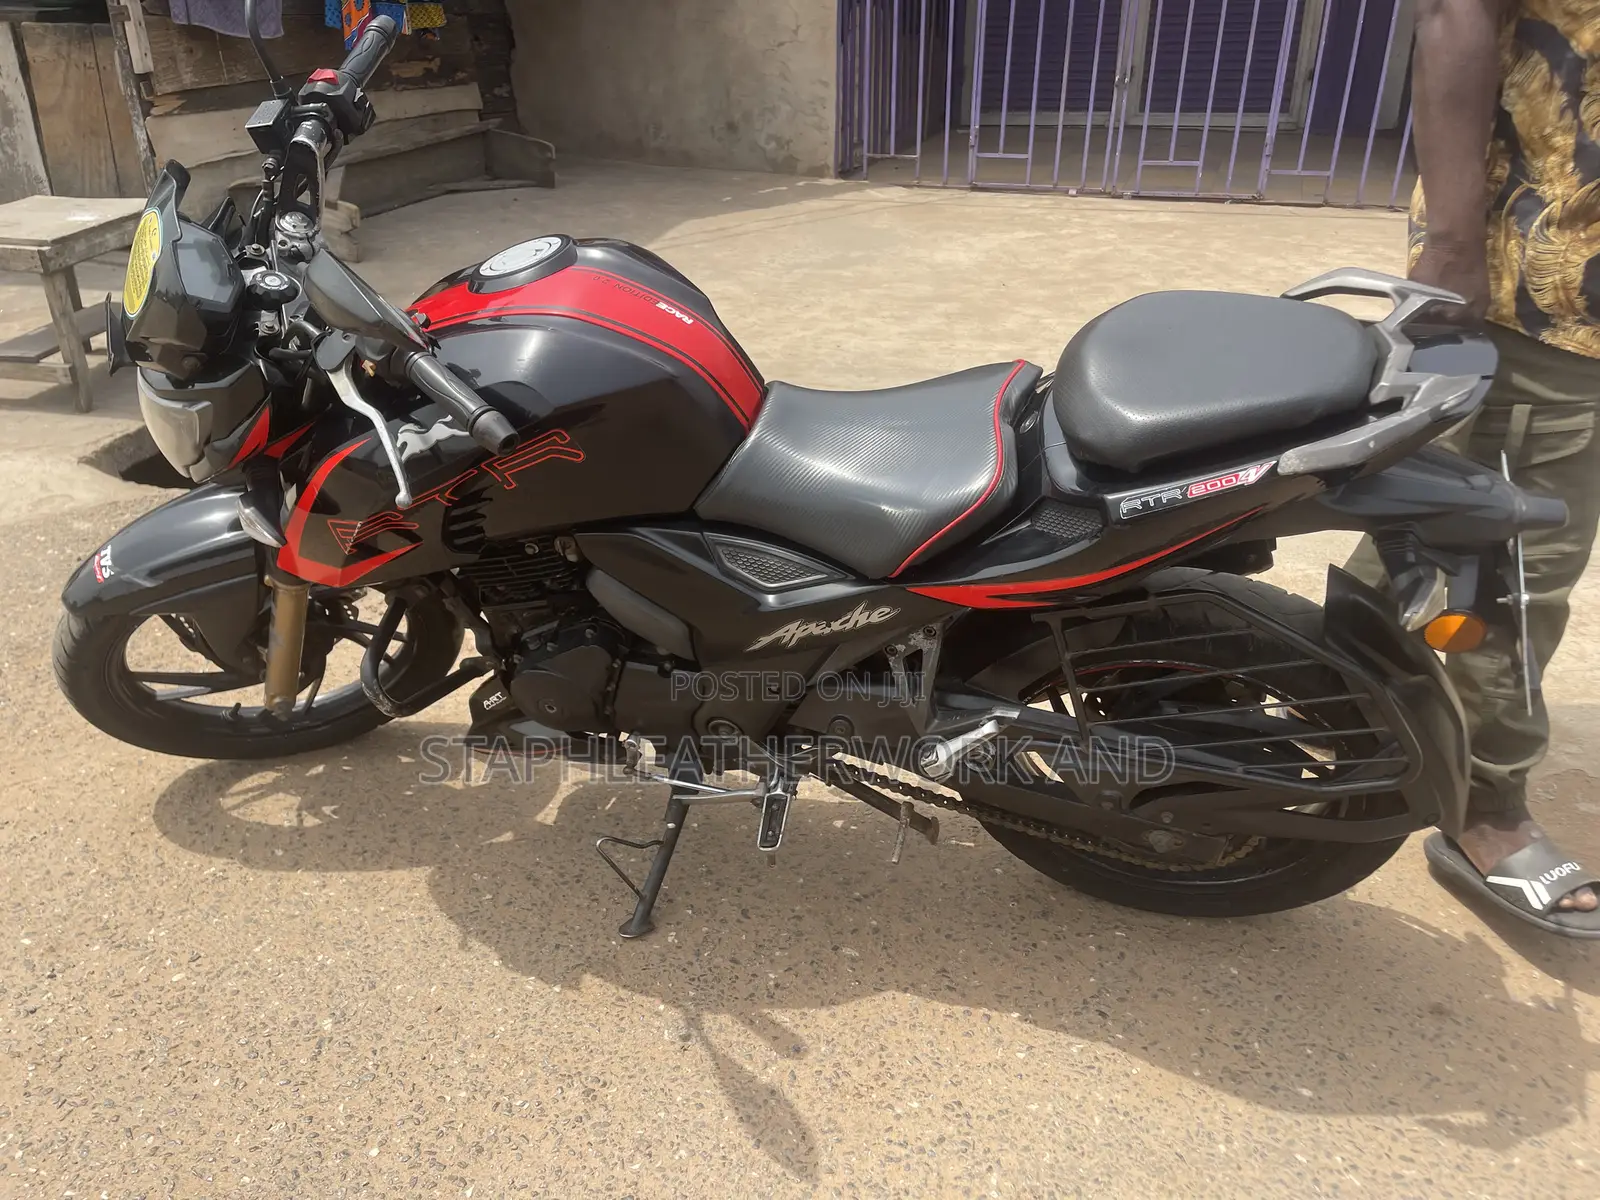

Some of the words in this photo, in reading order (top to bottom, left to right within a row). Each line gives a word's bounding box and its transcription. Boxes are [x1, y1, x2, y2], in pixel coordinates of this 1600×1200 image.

[614, 283, 661, 305] EDITION
[656, 302, 694, 325] RACE
[1121, 488, 1183, 514] RTR
[100, 544, 115, 579] TVS
[743, 600, 902, 652] Apache
[1538, 861, 1581, 885] LUOFU
